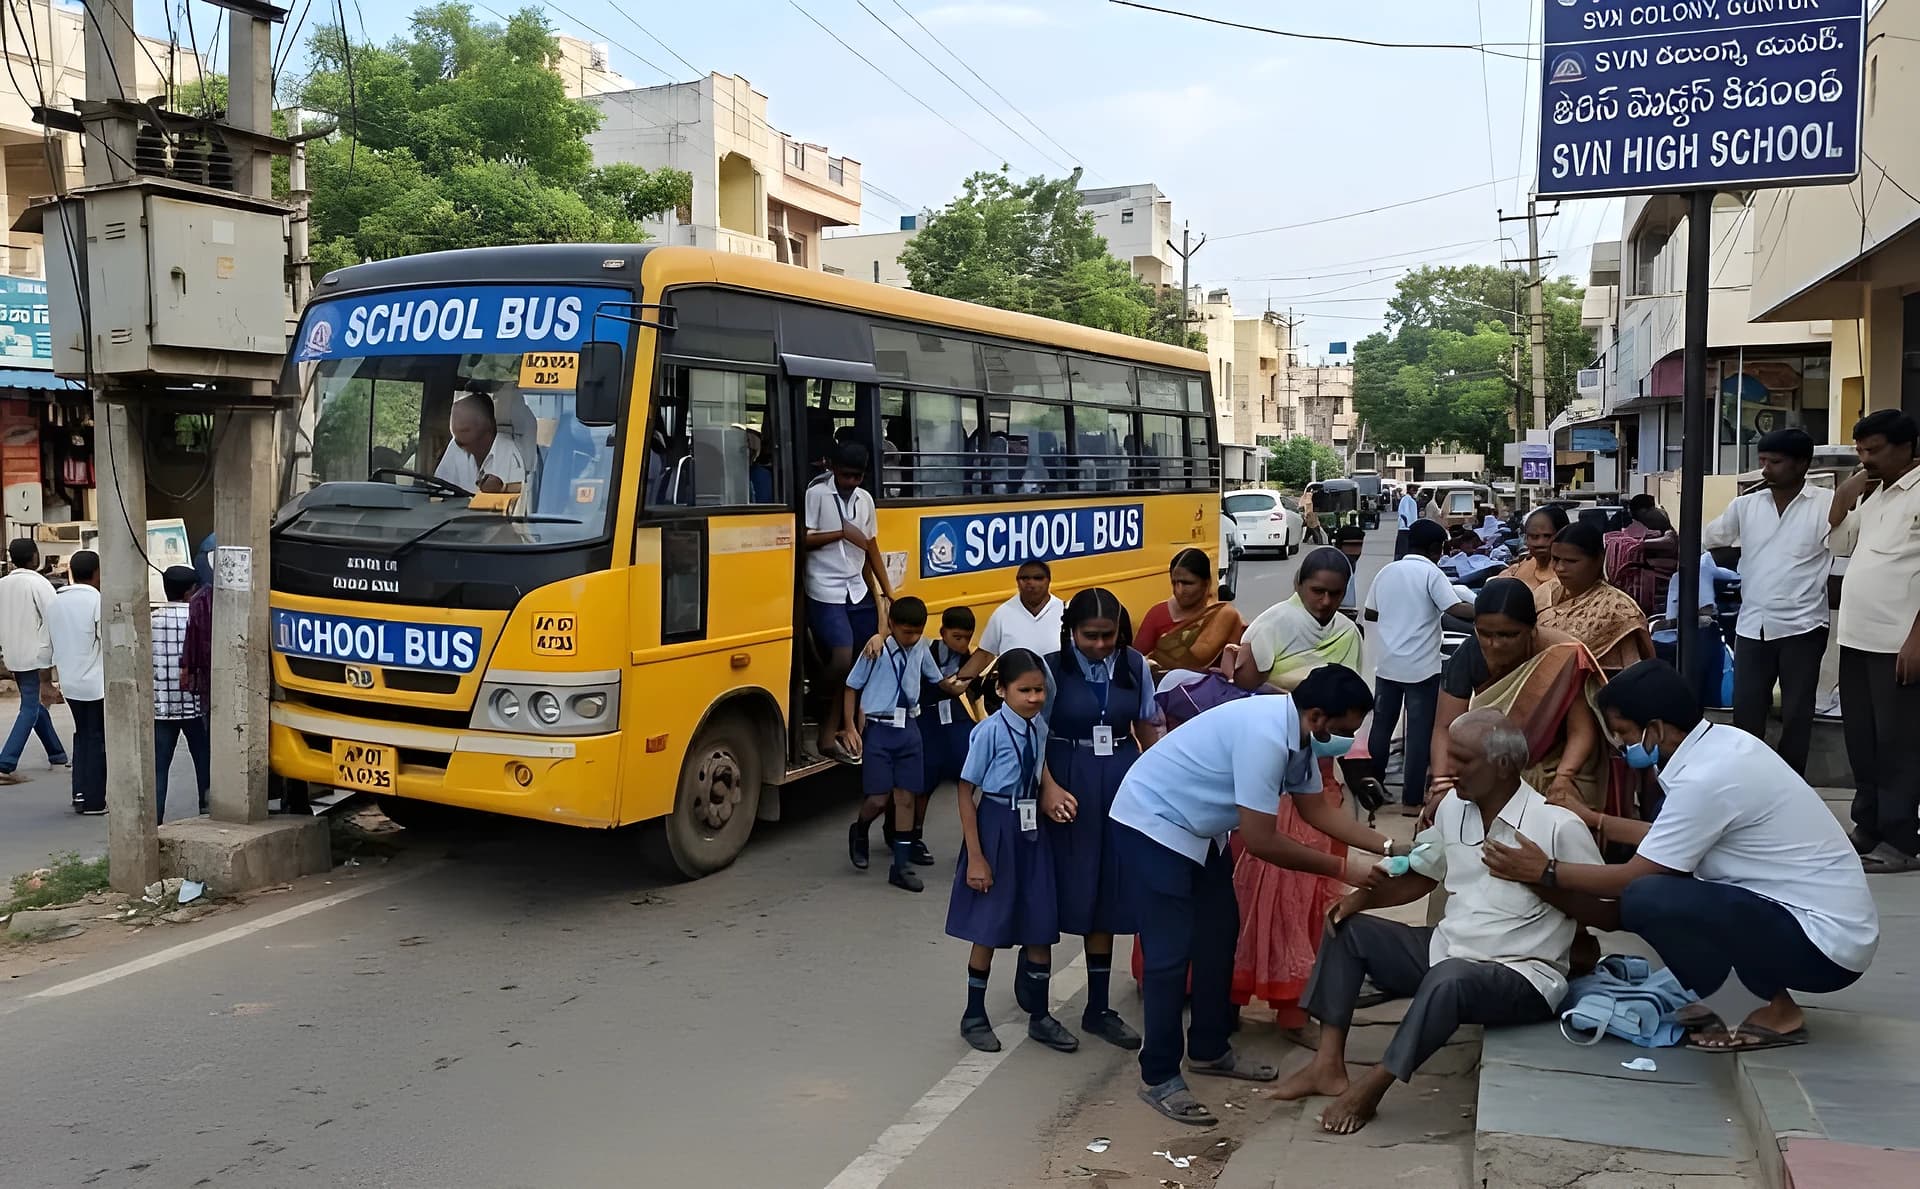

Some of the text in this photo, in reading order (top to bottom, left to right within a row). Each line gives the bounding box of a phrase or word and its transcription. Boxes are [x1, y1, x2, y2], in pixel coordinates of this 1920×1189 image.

[1630, 0, 1720, 25] COLONY,
[1594, 49, 1648, 72] SVN
[1552, 121, 1843, 179] SVN HIGH SCHOOL
[344, 296, 582, 348] SCHOOL BUS
[965, 511, 1085, 567] SCHOOL
[1092, 508, 1139, 550] BUS
[404, 618, 474, 669] BUS
